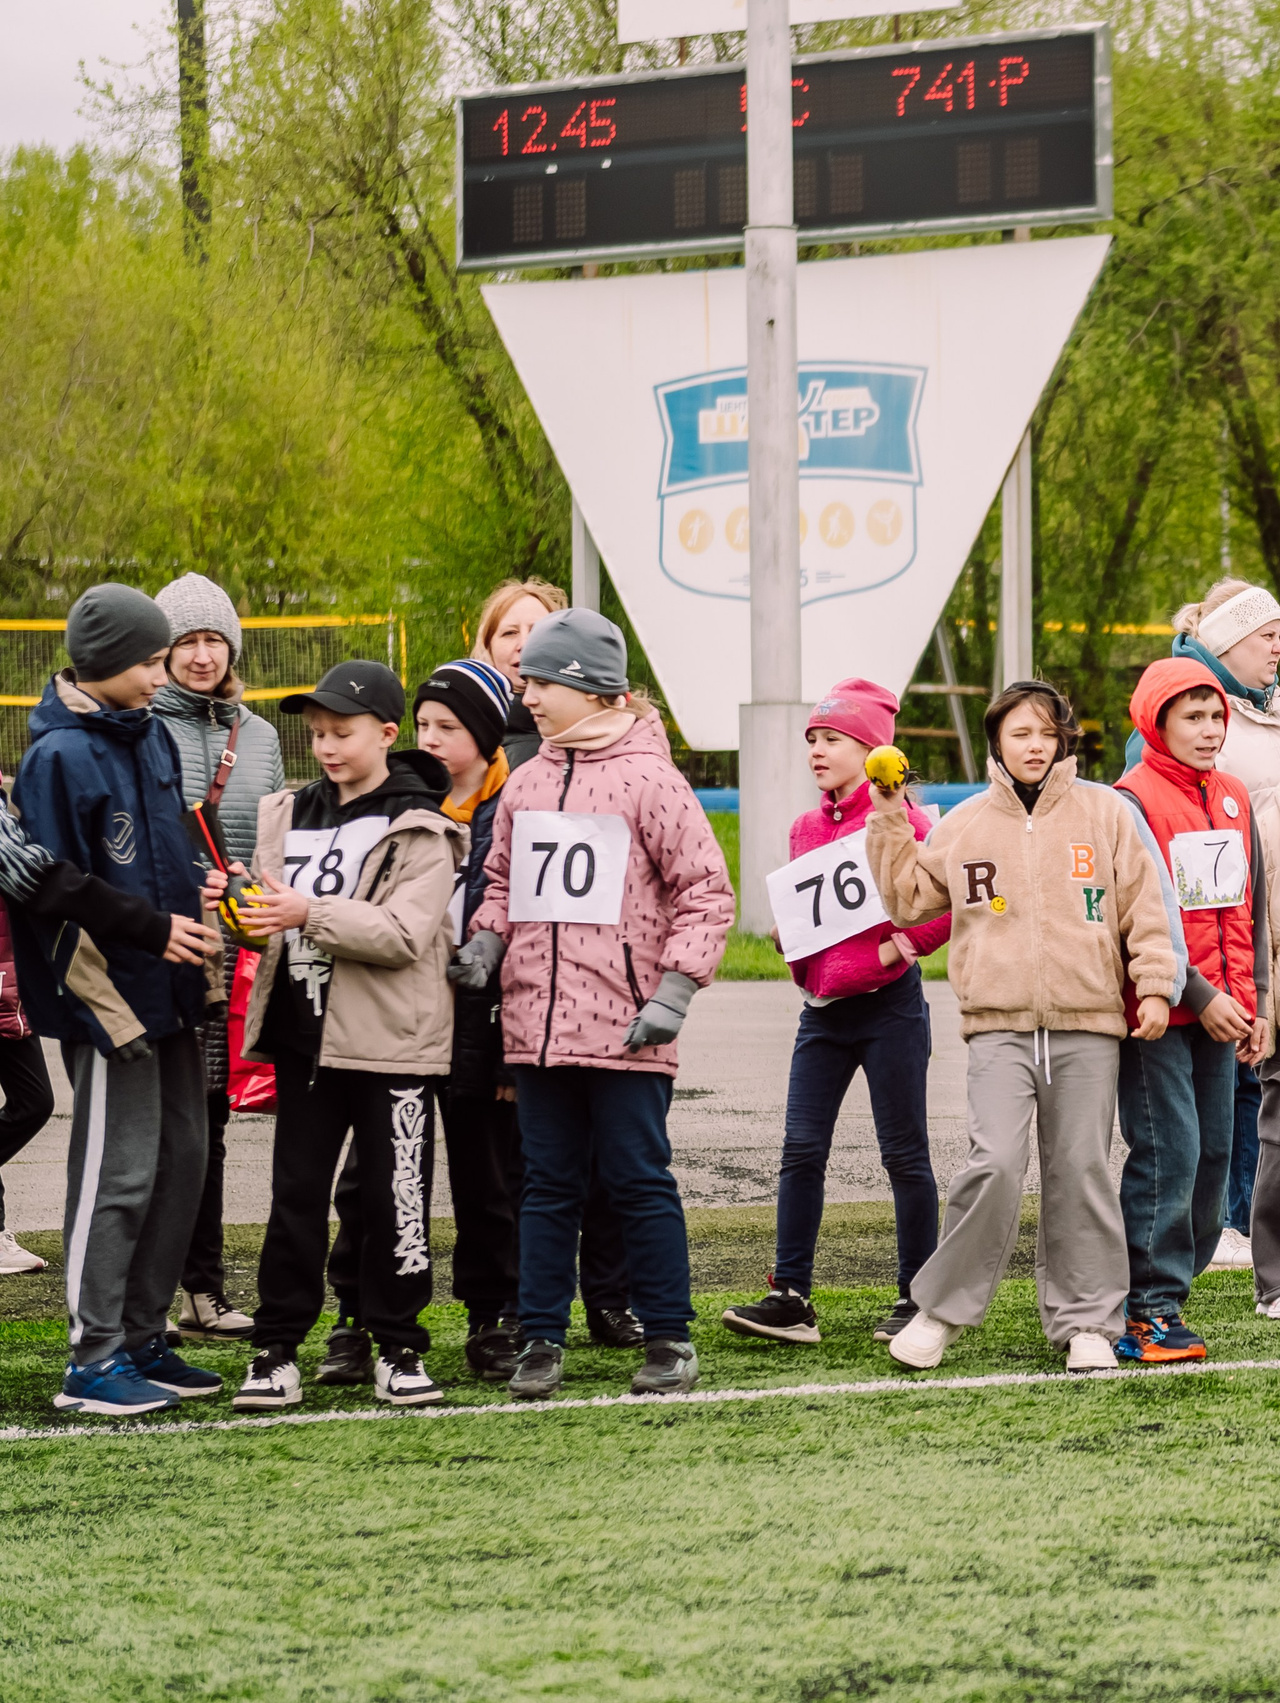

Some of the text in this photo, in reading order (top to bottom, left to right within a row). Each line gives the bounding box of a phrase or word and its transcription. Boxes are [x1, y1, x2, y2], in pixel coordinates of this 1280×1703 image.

[493, 98, 617, 157] 12.45
[284, 848, 344, 897] 78
[532, 841, 596, 898] 70
[1203, 840, 1230, 887] 7
[794, 860, 867, 928] 76
